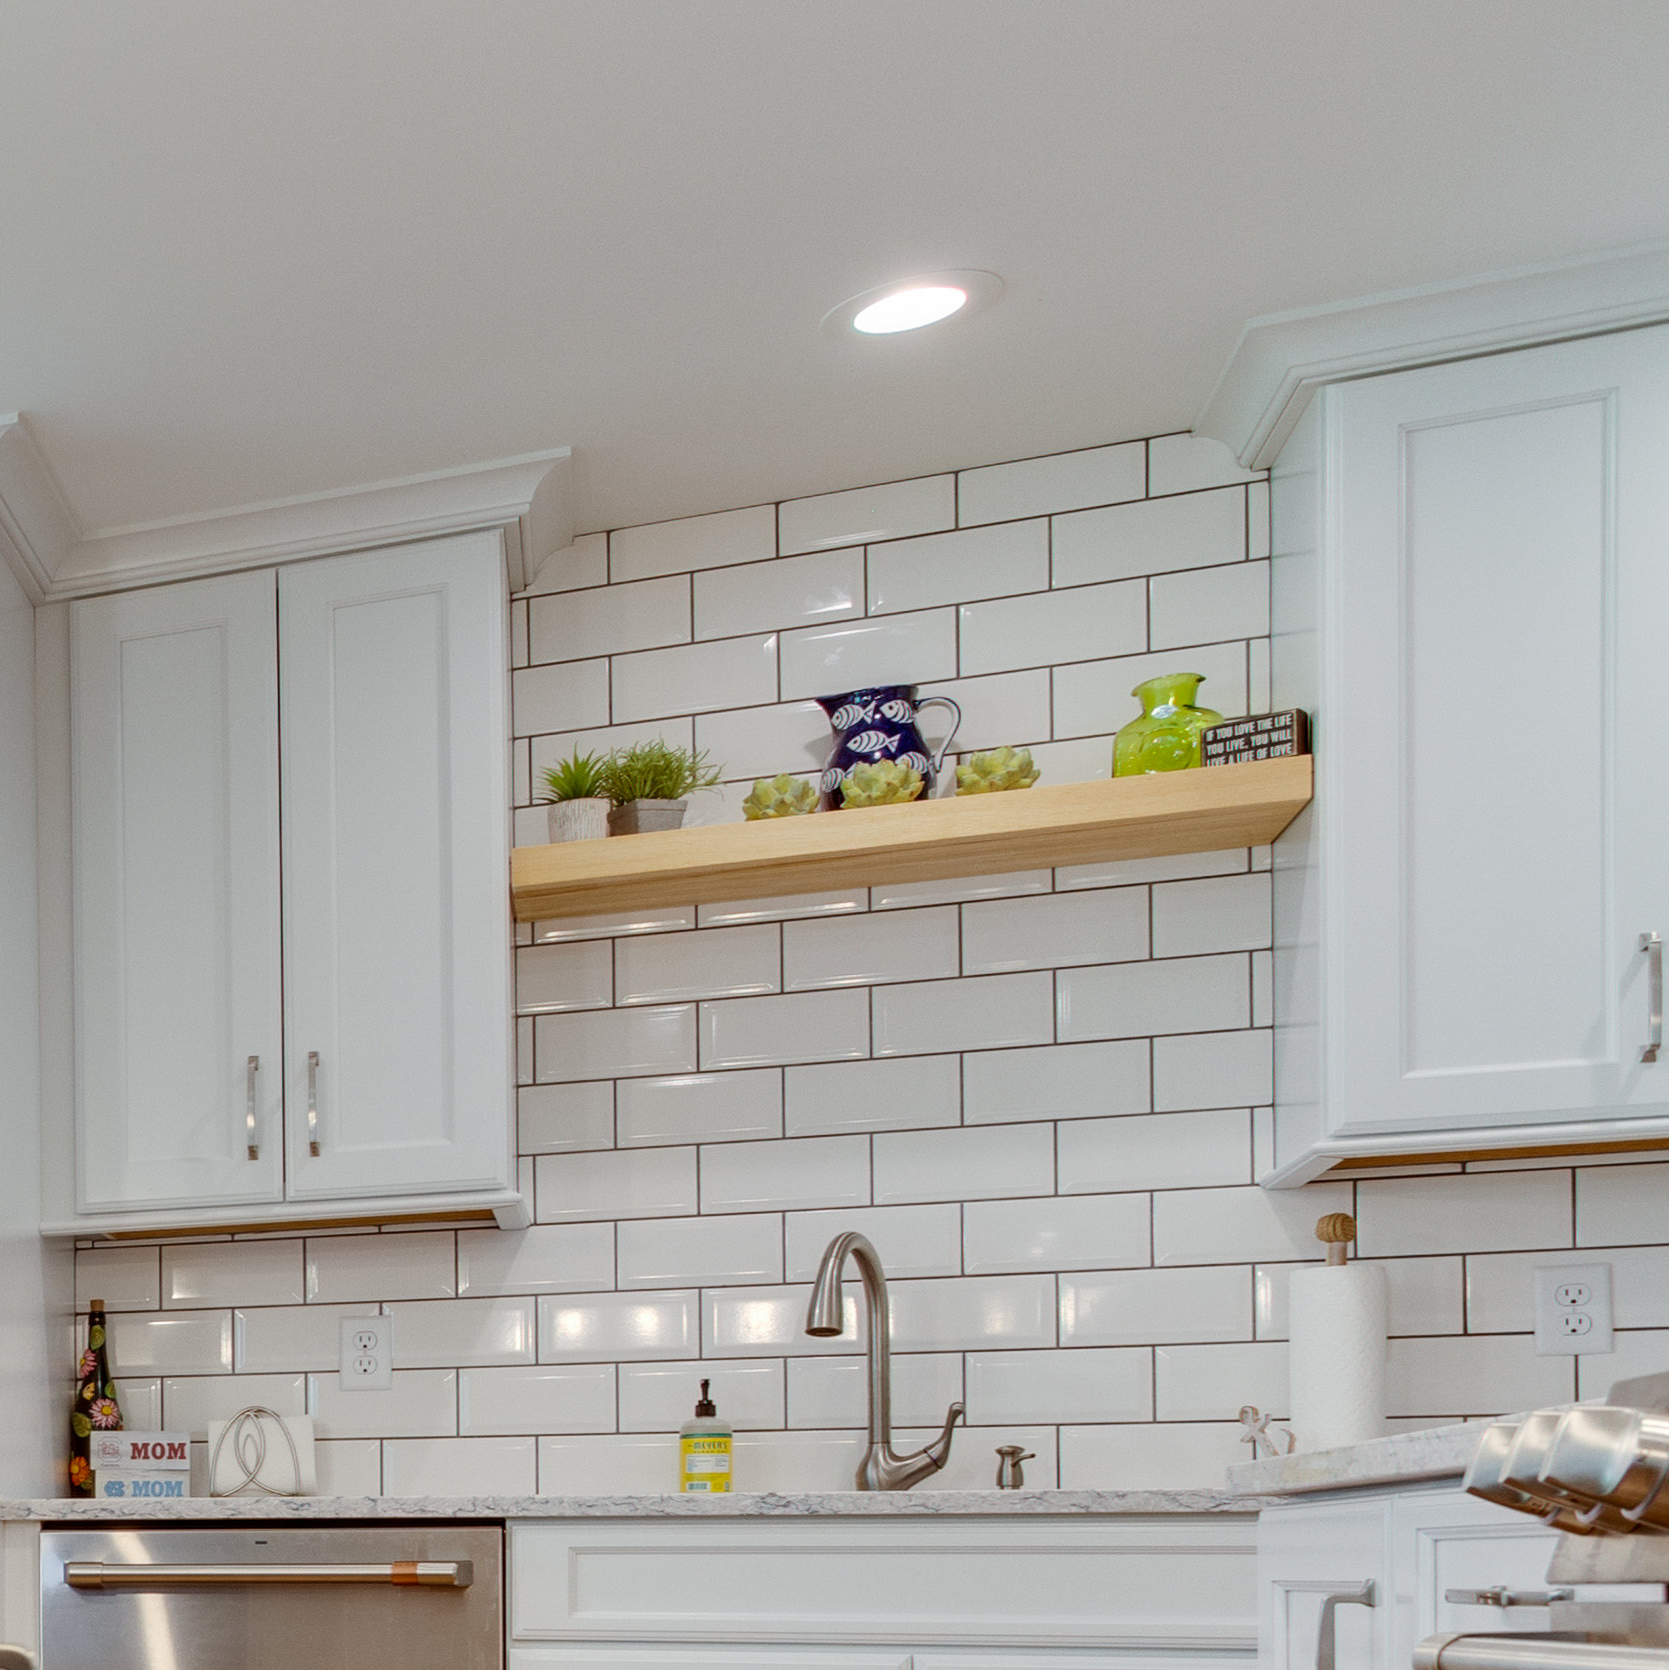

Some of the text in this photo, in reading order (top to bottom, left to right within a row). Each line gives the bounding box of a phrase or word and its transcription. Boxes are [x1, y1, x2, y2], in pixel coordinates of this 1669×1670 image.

[1206, 713, 1293, 742] IF YOU LOVE THE LIFE
[1206, 744, 1224, 756] YOU
[1250, 733, 1269, 747] YOU
[1270, 728, 1292, 743] WILL
[1237, 750, 1255, 764] LIFE
[1256, 747, 1269, 760] OF
[1270, 742, 1292, 757] LOVE
[130, 1442, 186, 1460] MOM
[131, 1480, 183, 1498] MOM
